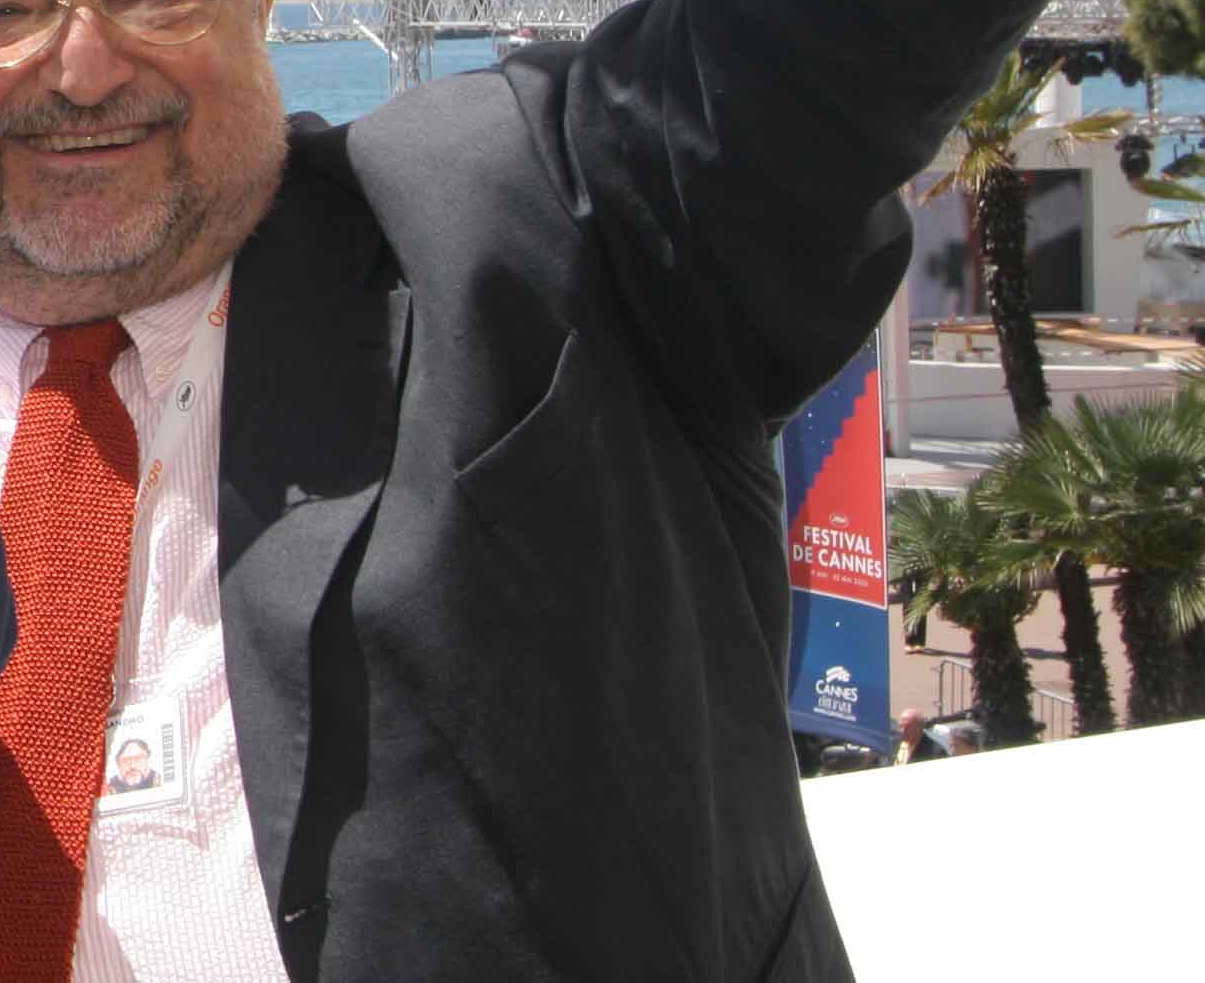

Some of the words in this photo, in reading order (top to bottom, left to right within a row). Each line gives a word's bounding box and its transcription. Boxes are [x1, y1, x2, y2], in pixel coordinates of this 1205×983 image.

[803, 525, 873, 555] FESTIVAL
[793, 544, 813, 564] DE
[818, 548, 882, 579] CANNES
[815, 678, 858, 703] CANNES
